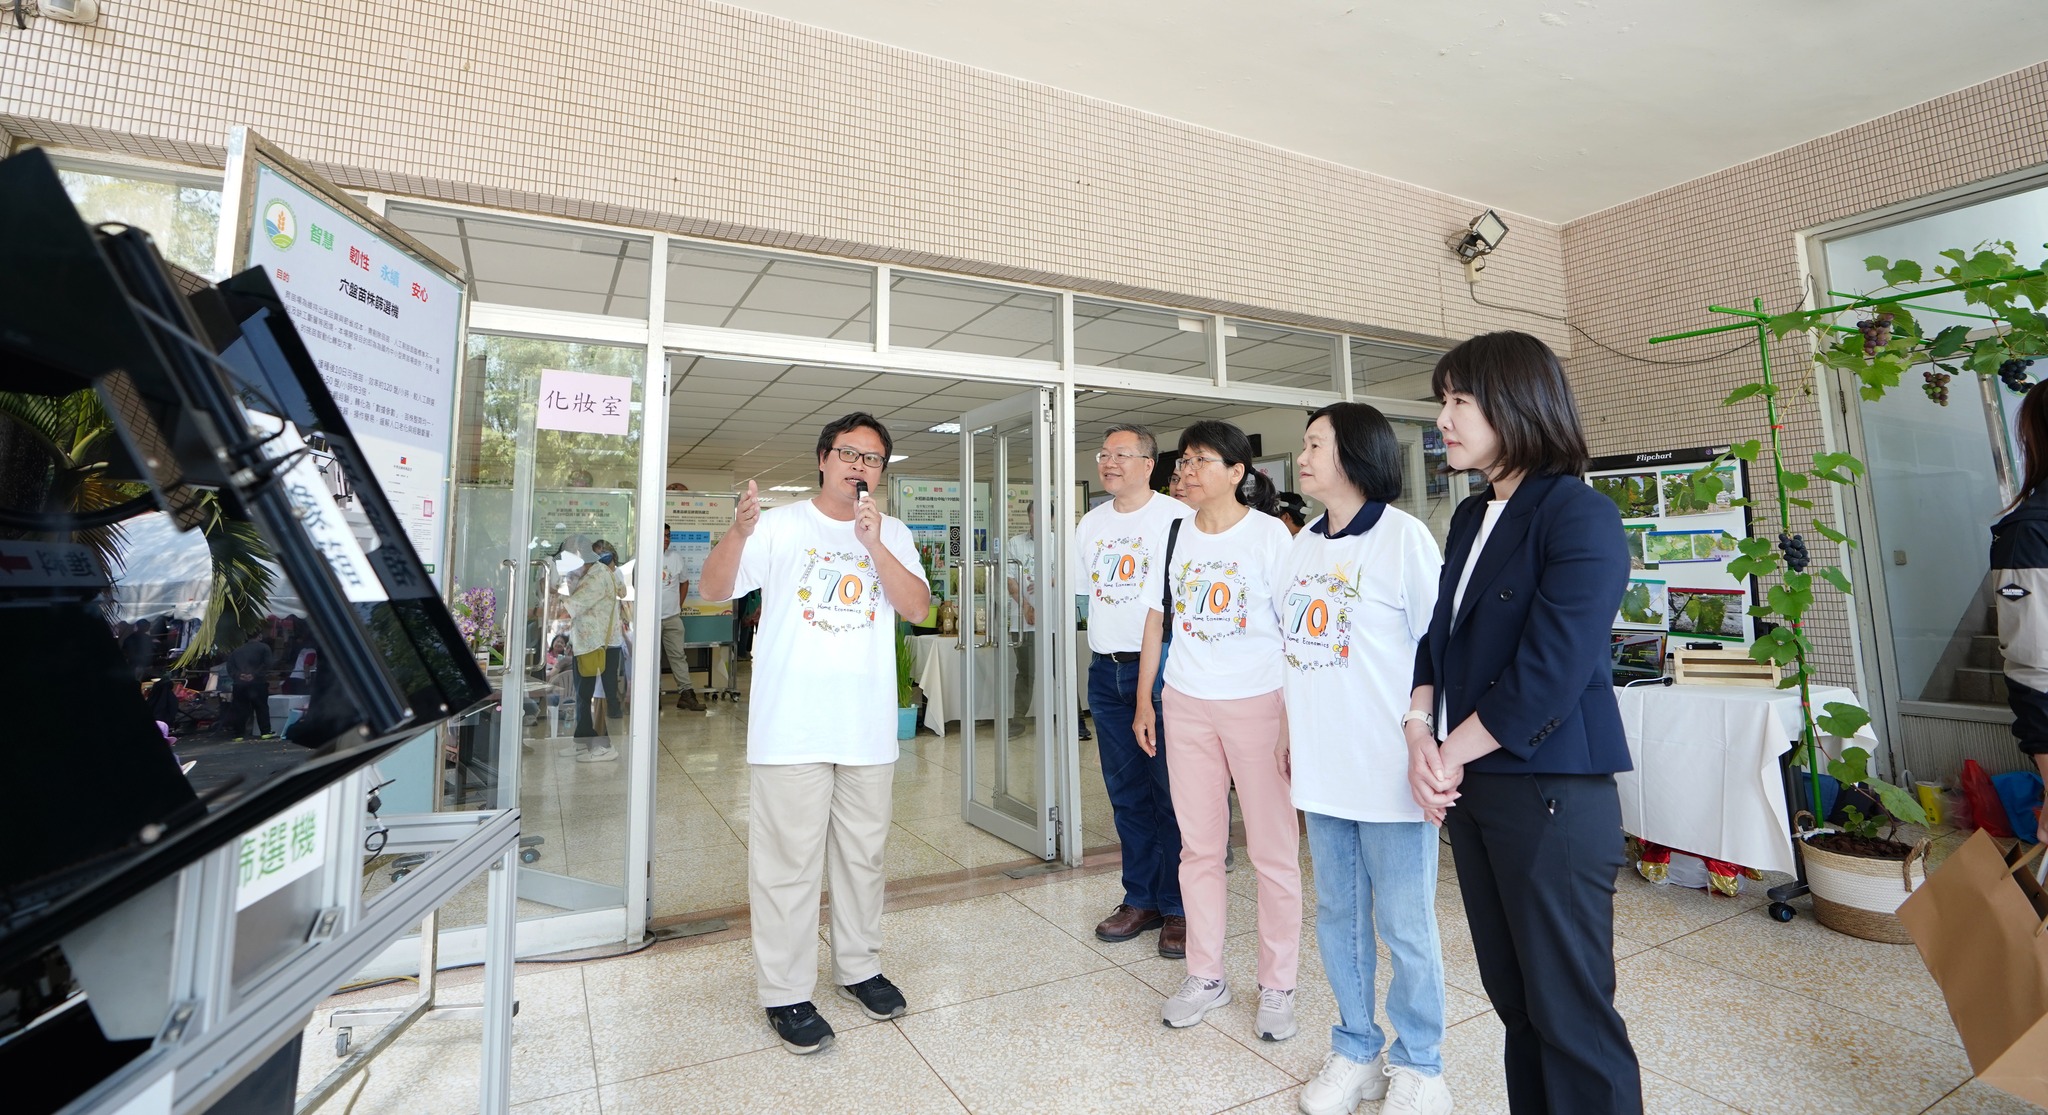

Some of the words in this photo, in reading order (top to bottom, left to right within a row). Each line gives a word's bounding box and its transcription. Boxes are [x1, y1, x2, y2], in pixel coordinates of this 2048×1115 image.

[309, 222, 335, 251] 智慧
[349, 245, 370, 272] 韌性
[380, 264, 400, 288] 永續
[411, 282, 429, 303] 安心
[275, 268, 290, 283] 目的
[338, 278, 400, 319] 穴盤苗株篩選機
[544, 389, 622, 417] 化妝室
[1635, 452, 1673, 463] Flipchart
[817, 603, 831, 611] Home
[834, 605, 862, 614] Economics
